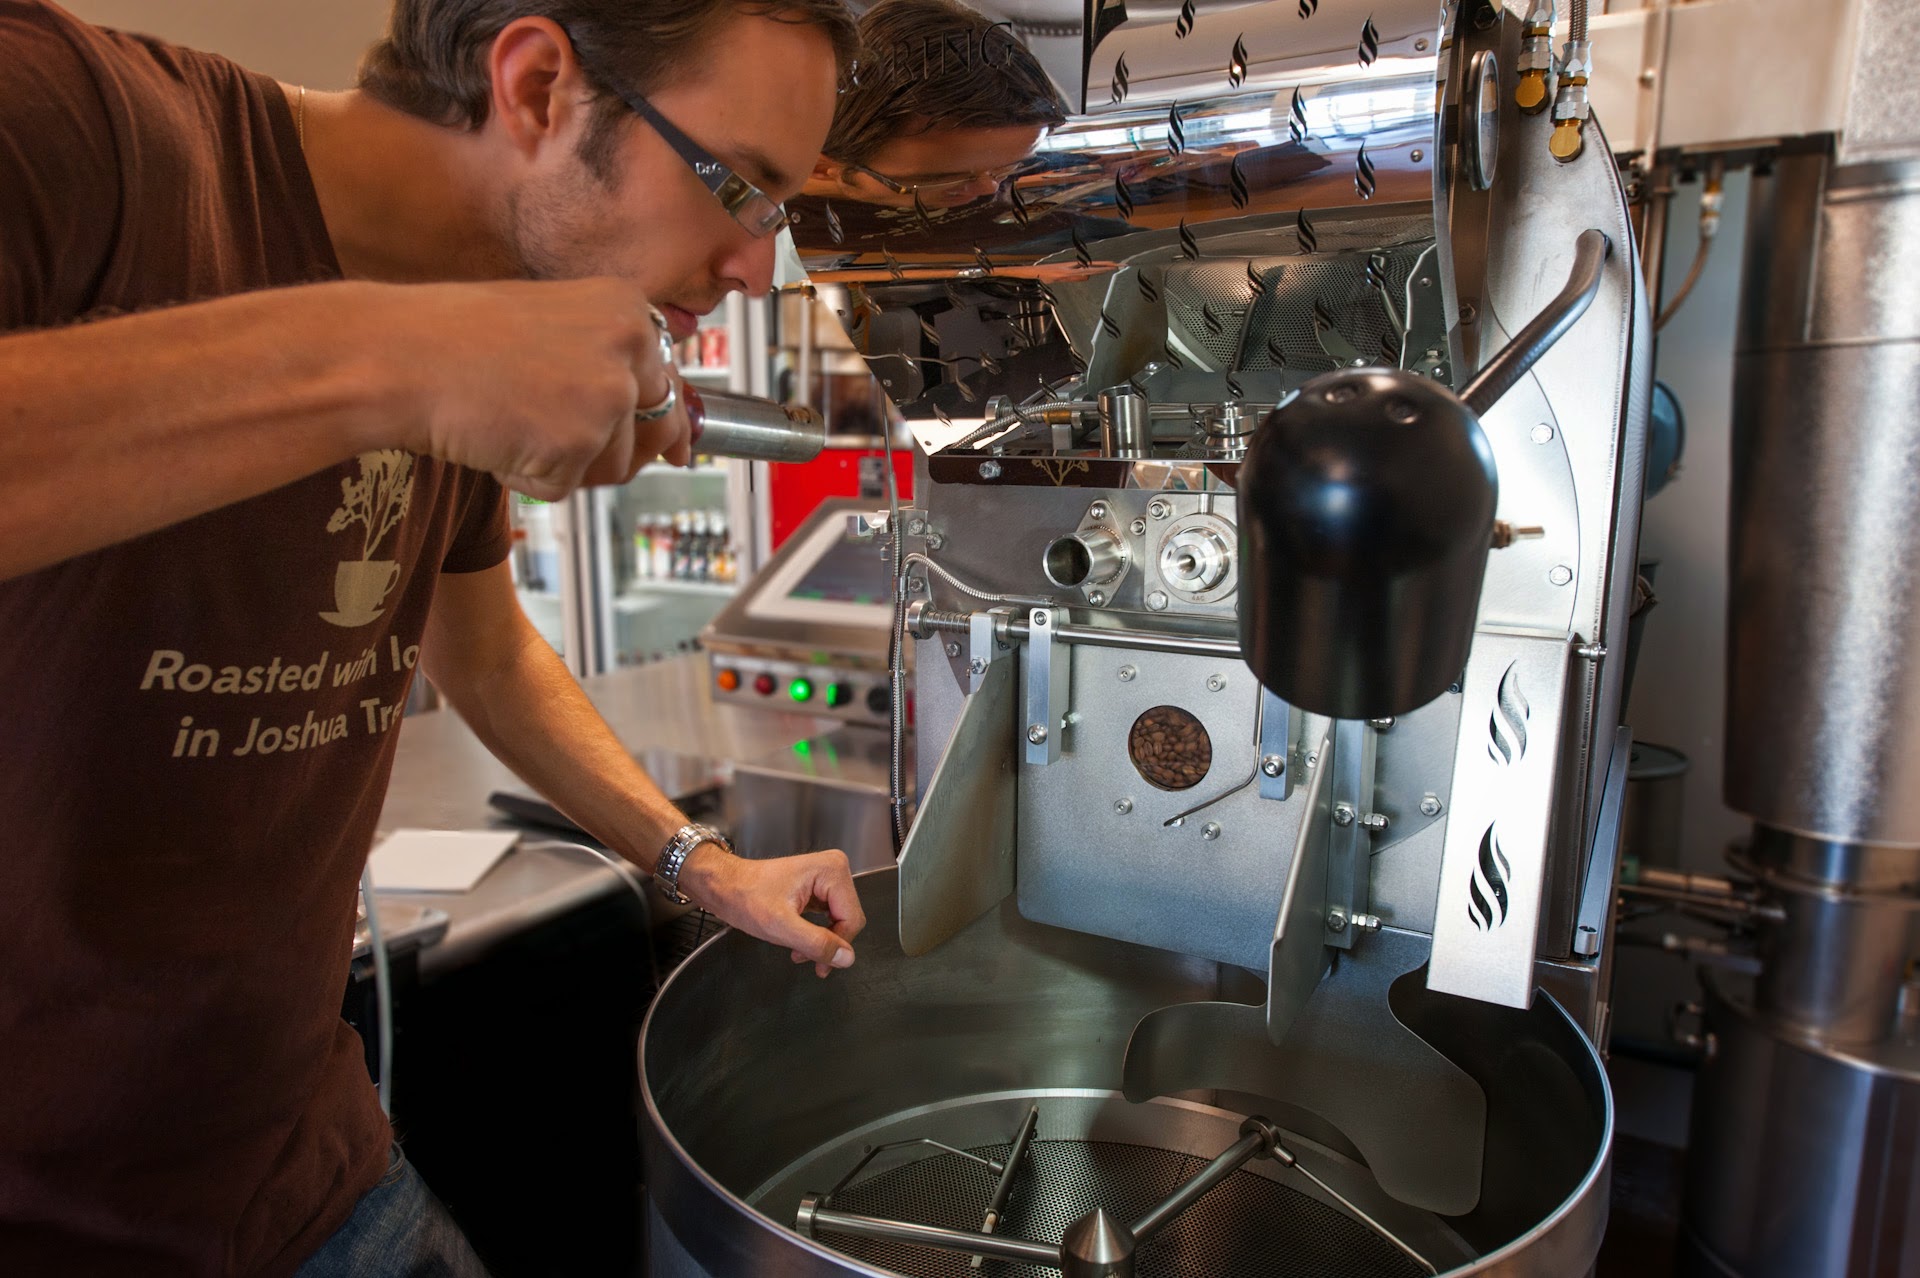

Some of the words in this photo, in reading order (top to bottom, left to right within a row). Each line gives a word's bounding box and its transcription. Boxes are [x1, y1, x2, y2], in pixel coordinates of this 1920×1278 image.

[140, 650, 328, 694] Roasted
[390, 635, 420, 671] lo
[171, 715, 220, 758] in
[233, 710, 348, 757] Joshua
[360, 697, 404, 734] Tre
